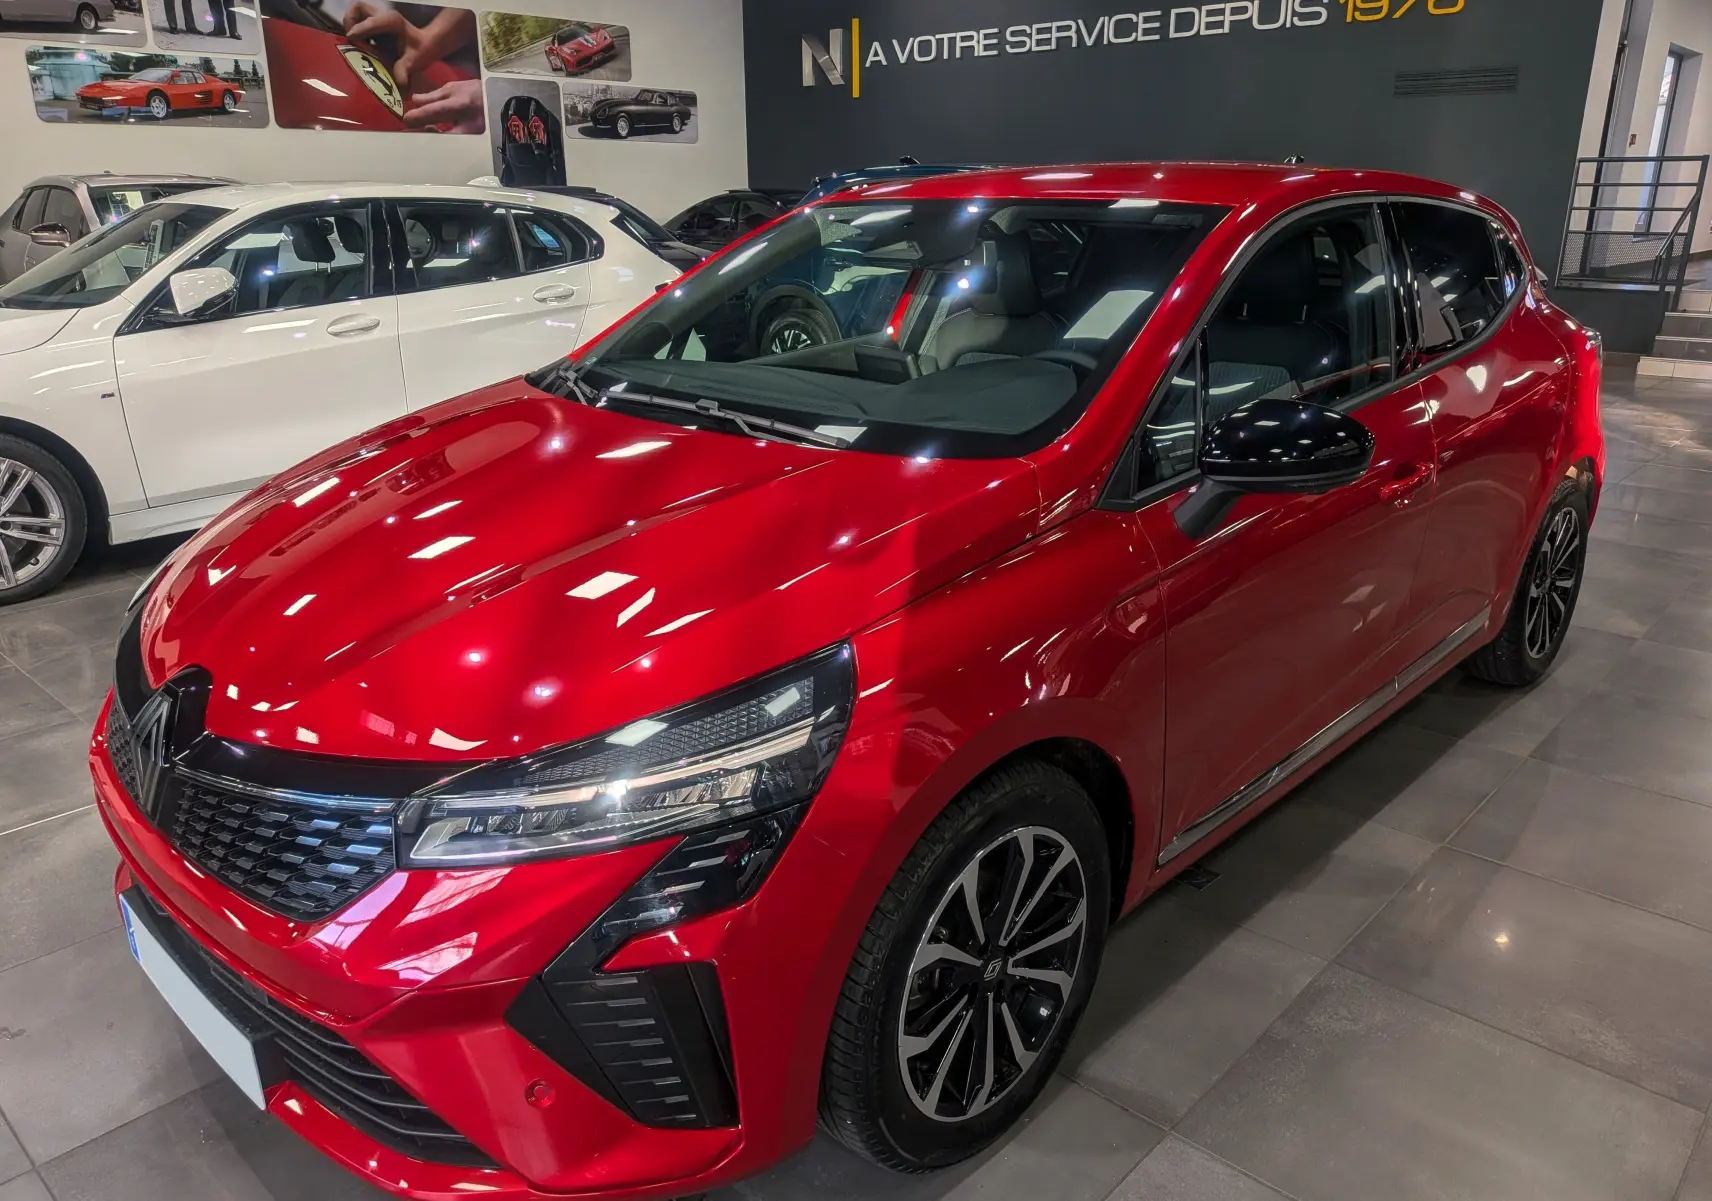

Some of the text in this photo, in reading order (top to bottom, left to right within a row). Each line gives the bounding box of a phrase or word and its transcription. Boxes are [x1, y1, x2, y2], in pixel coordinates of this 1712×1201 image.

[801, 28, 845, 87] N
[865, 41, 888, 68] A
[892, 28, 1000, 64] VOTRE
[1005, 10, 1163, 53] SERVICE
[1168, 0, 1329, 38] DEPUIS
